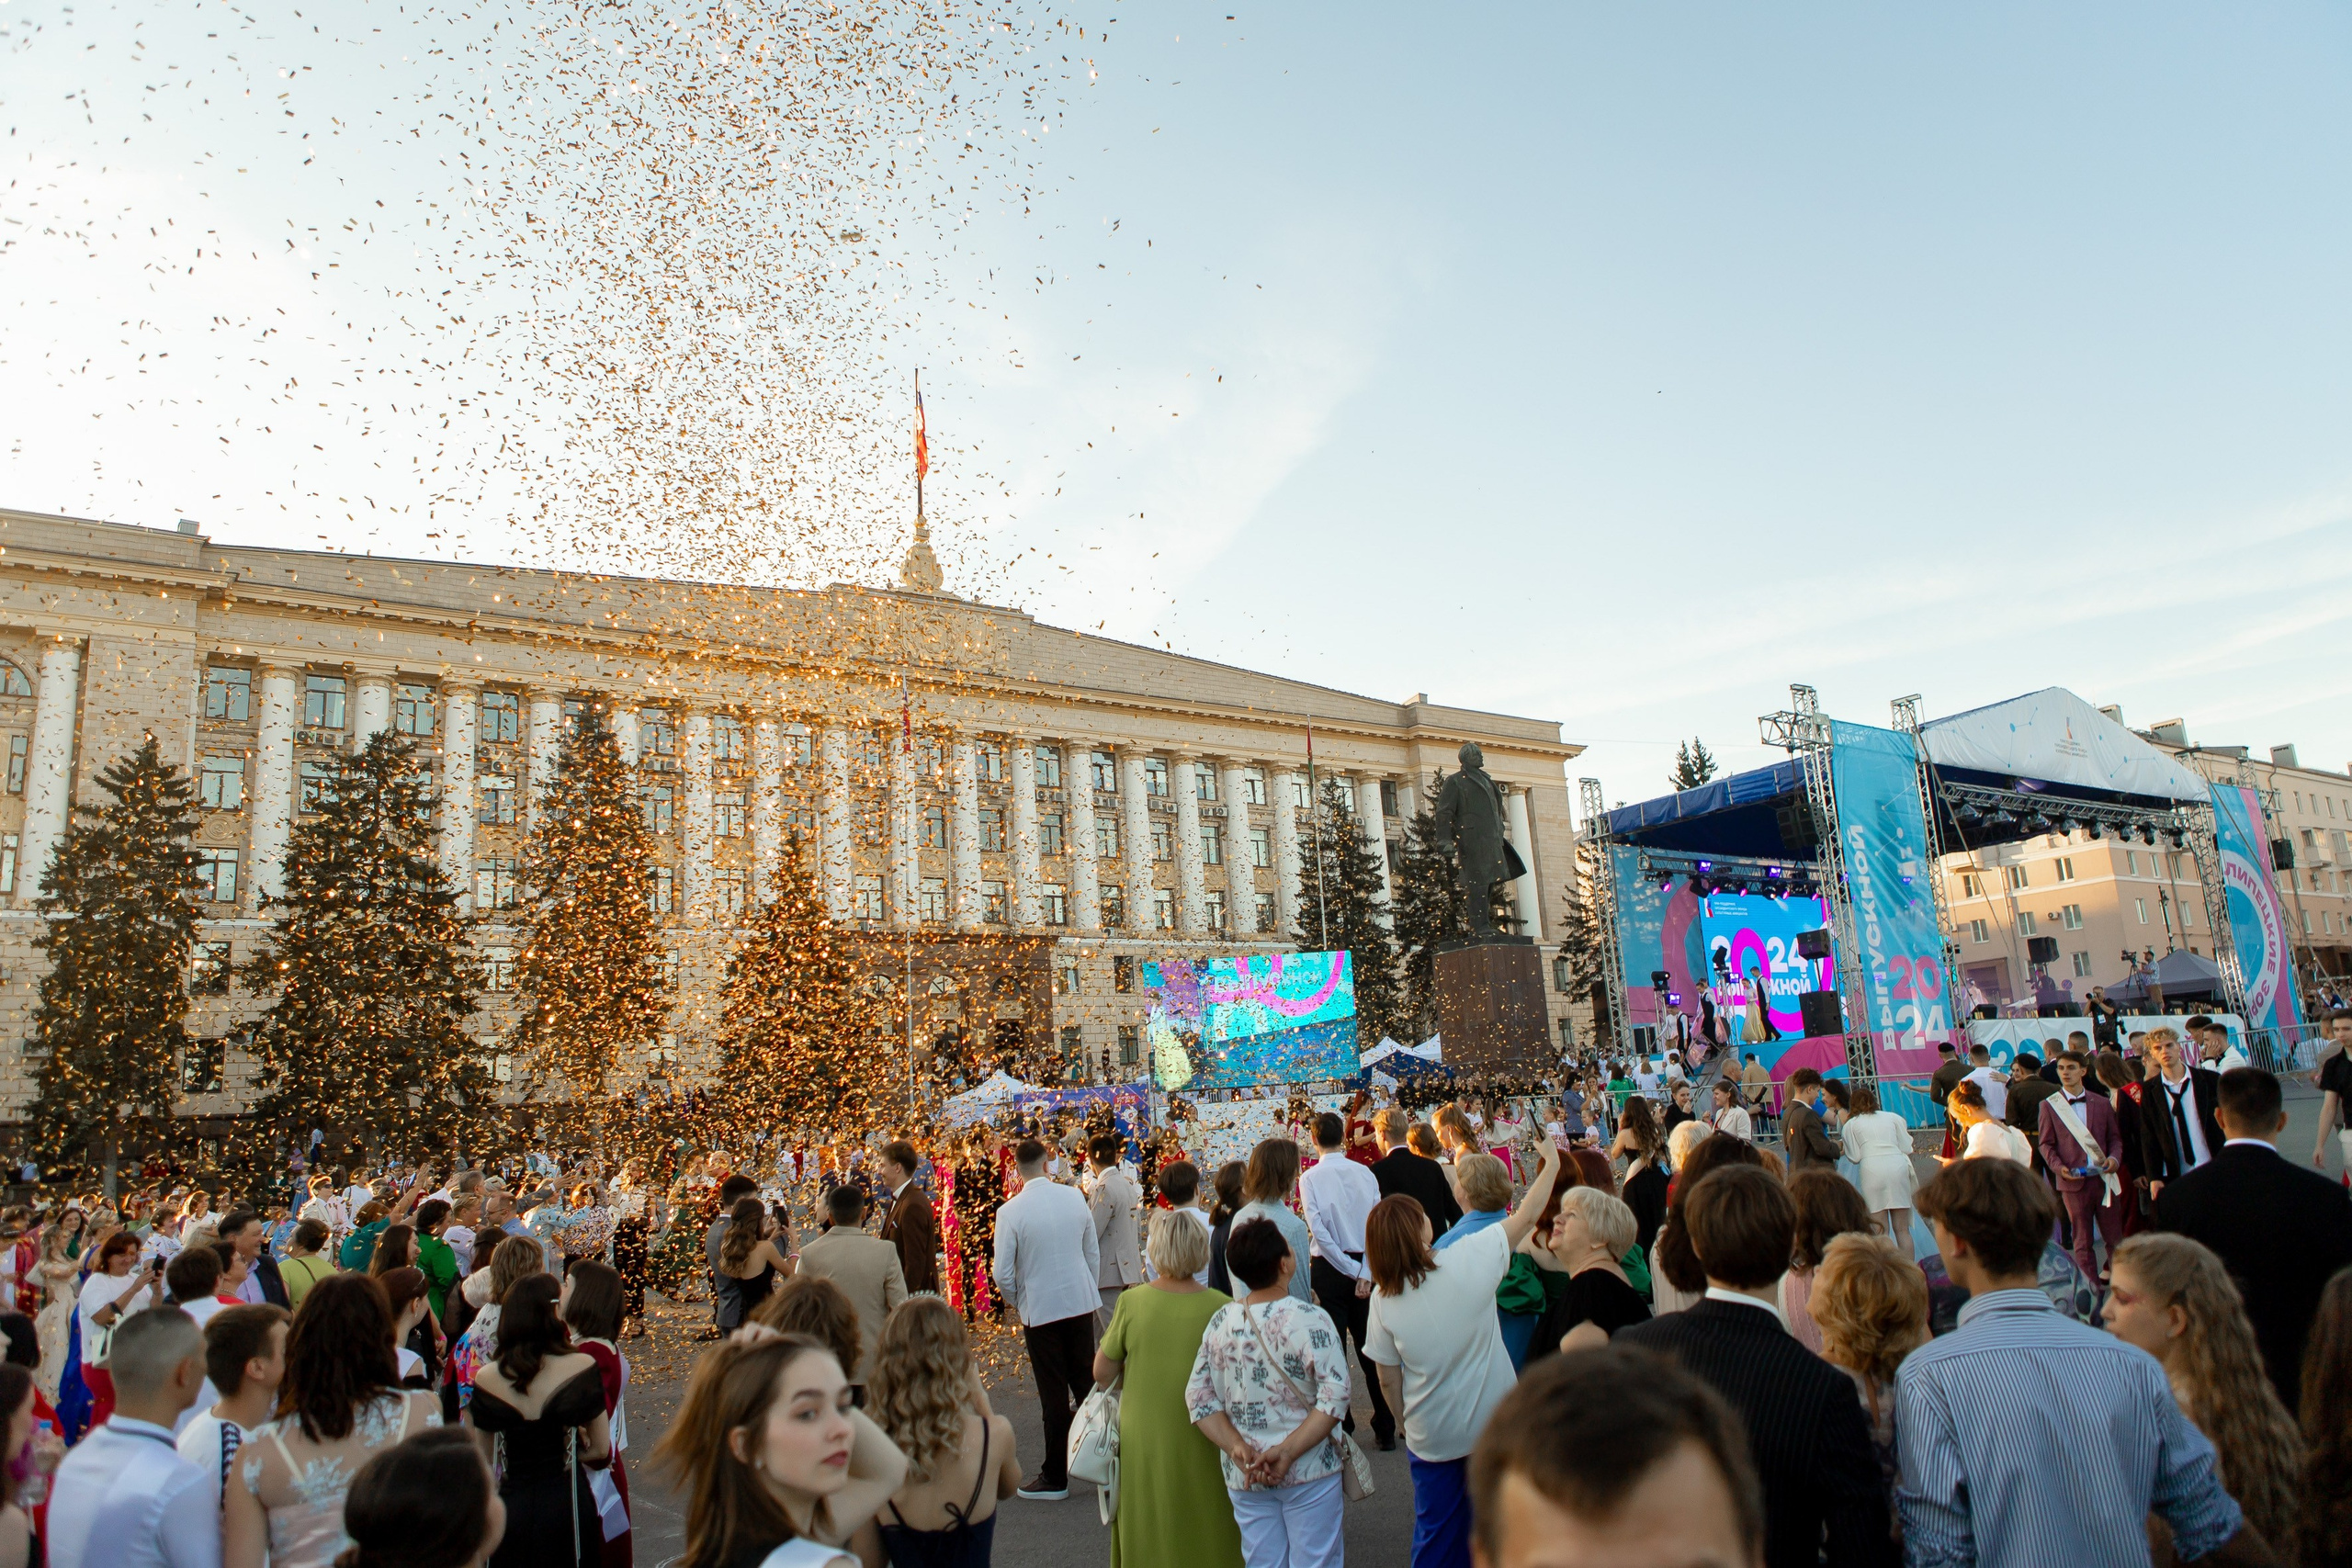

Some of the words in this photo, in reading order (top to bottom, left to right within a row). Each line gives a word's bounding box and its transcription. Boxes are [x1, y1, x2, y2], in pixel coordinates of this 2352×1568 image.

[1848, 825, 1896, 1051] ВЫПУСКНОЙ
[2224, 862, 2276, 976] ЛИПЕЦКИЕ
[1889, 954, 1941, 1000] 20
[1895, 1004, 1951, 1051] 24
